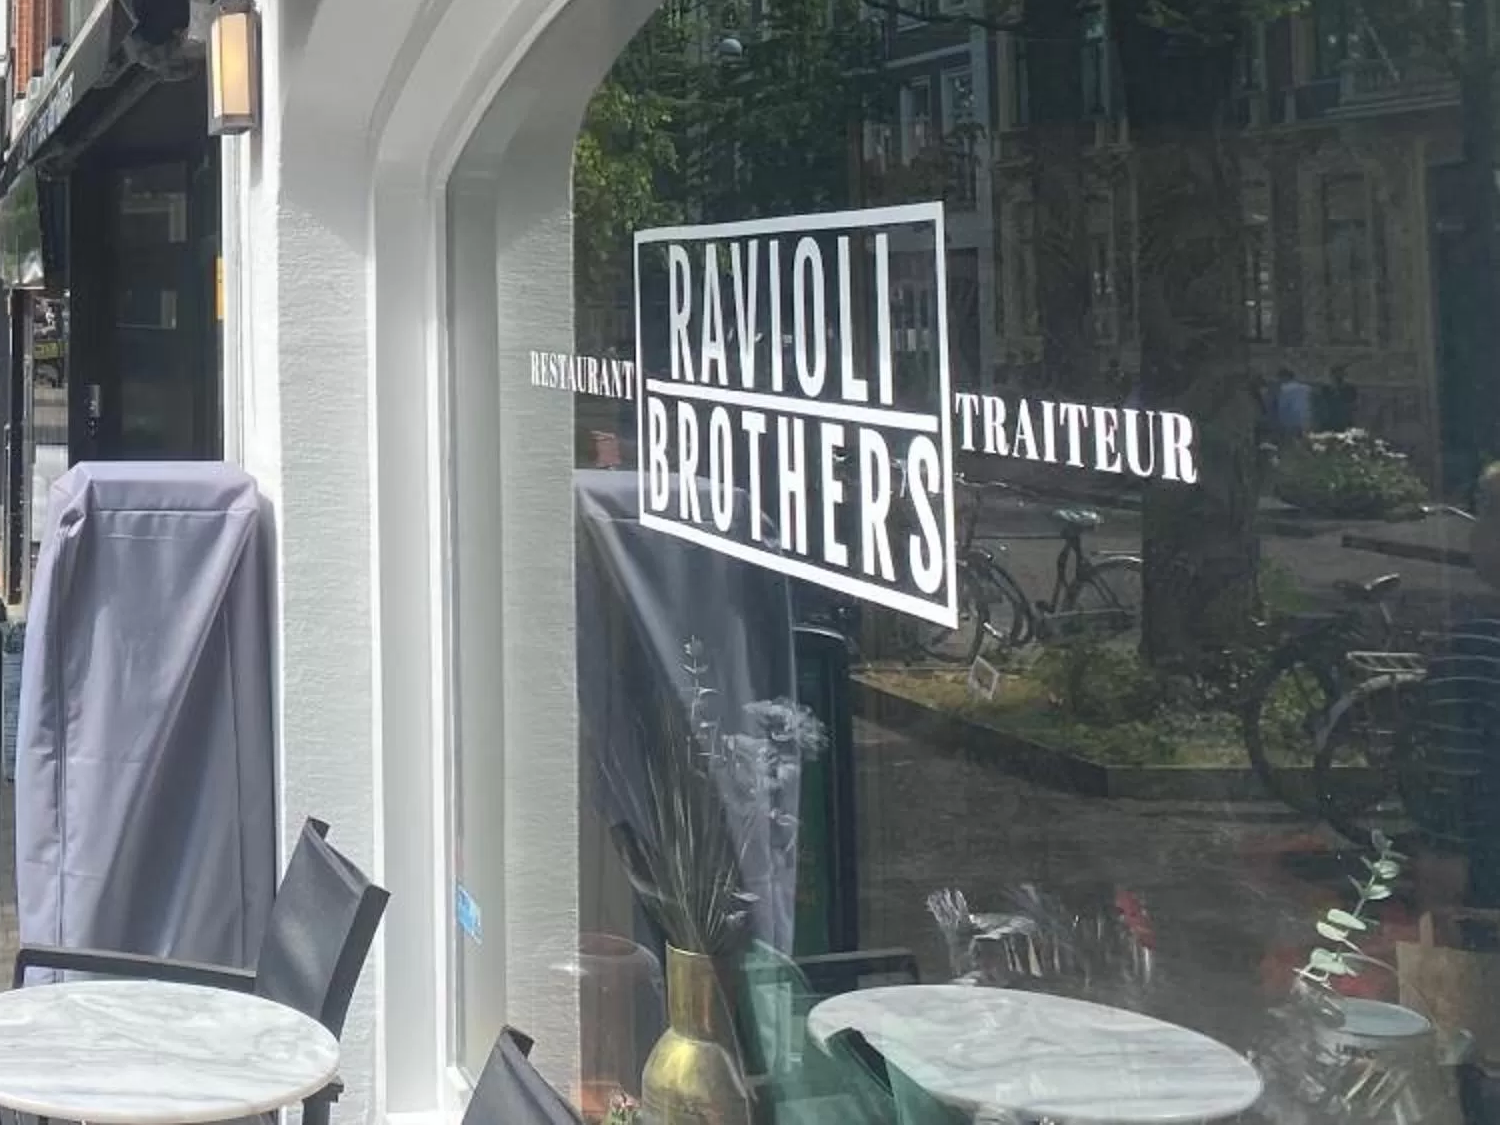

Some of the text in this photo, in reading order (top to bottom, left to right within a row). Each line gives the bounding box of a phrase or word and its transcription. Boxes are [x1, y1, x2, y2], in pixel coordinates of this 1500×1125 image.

[530, 350, 634, 400] RESTAURANT
[668, 232, 893, 405] RAVIOLI
[646, 396, 944, 595] BROTHERS
[955, 392, 1198, 484] TRAITEUR
